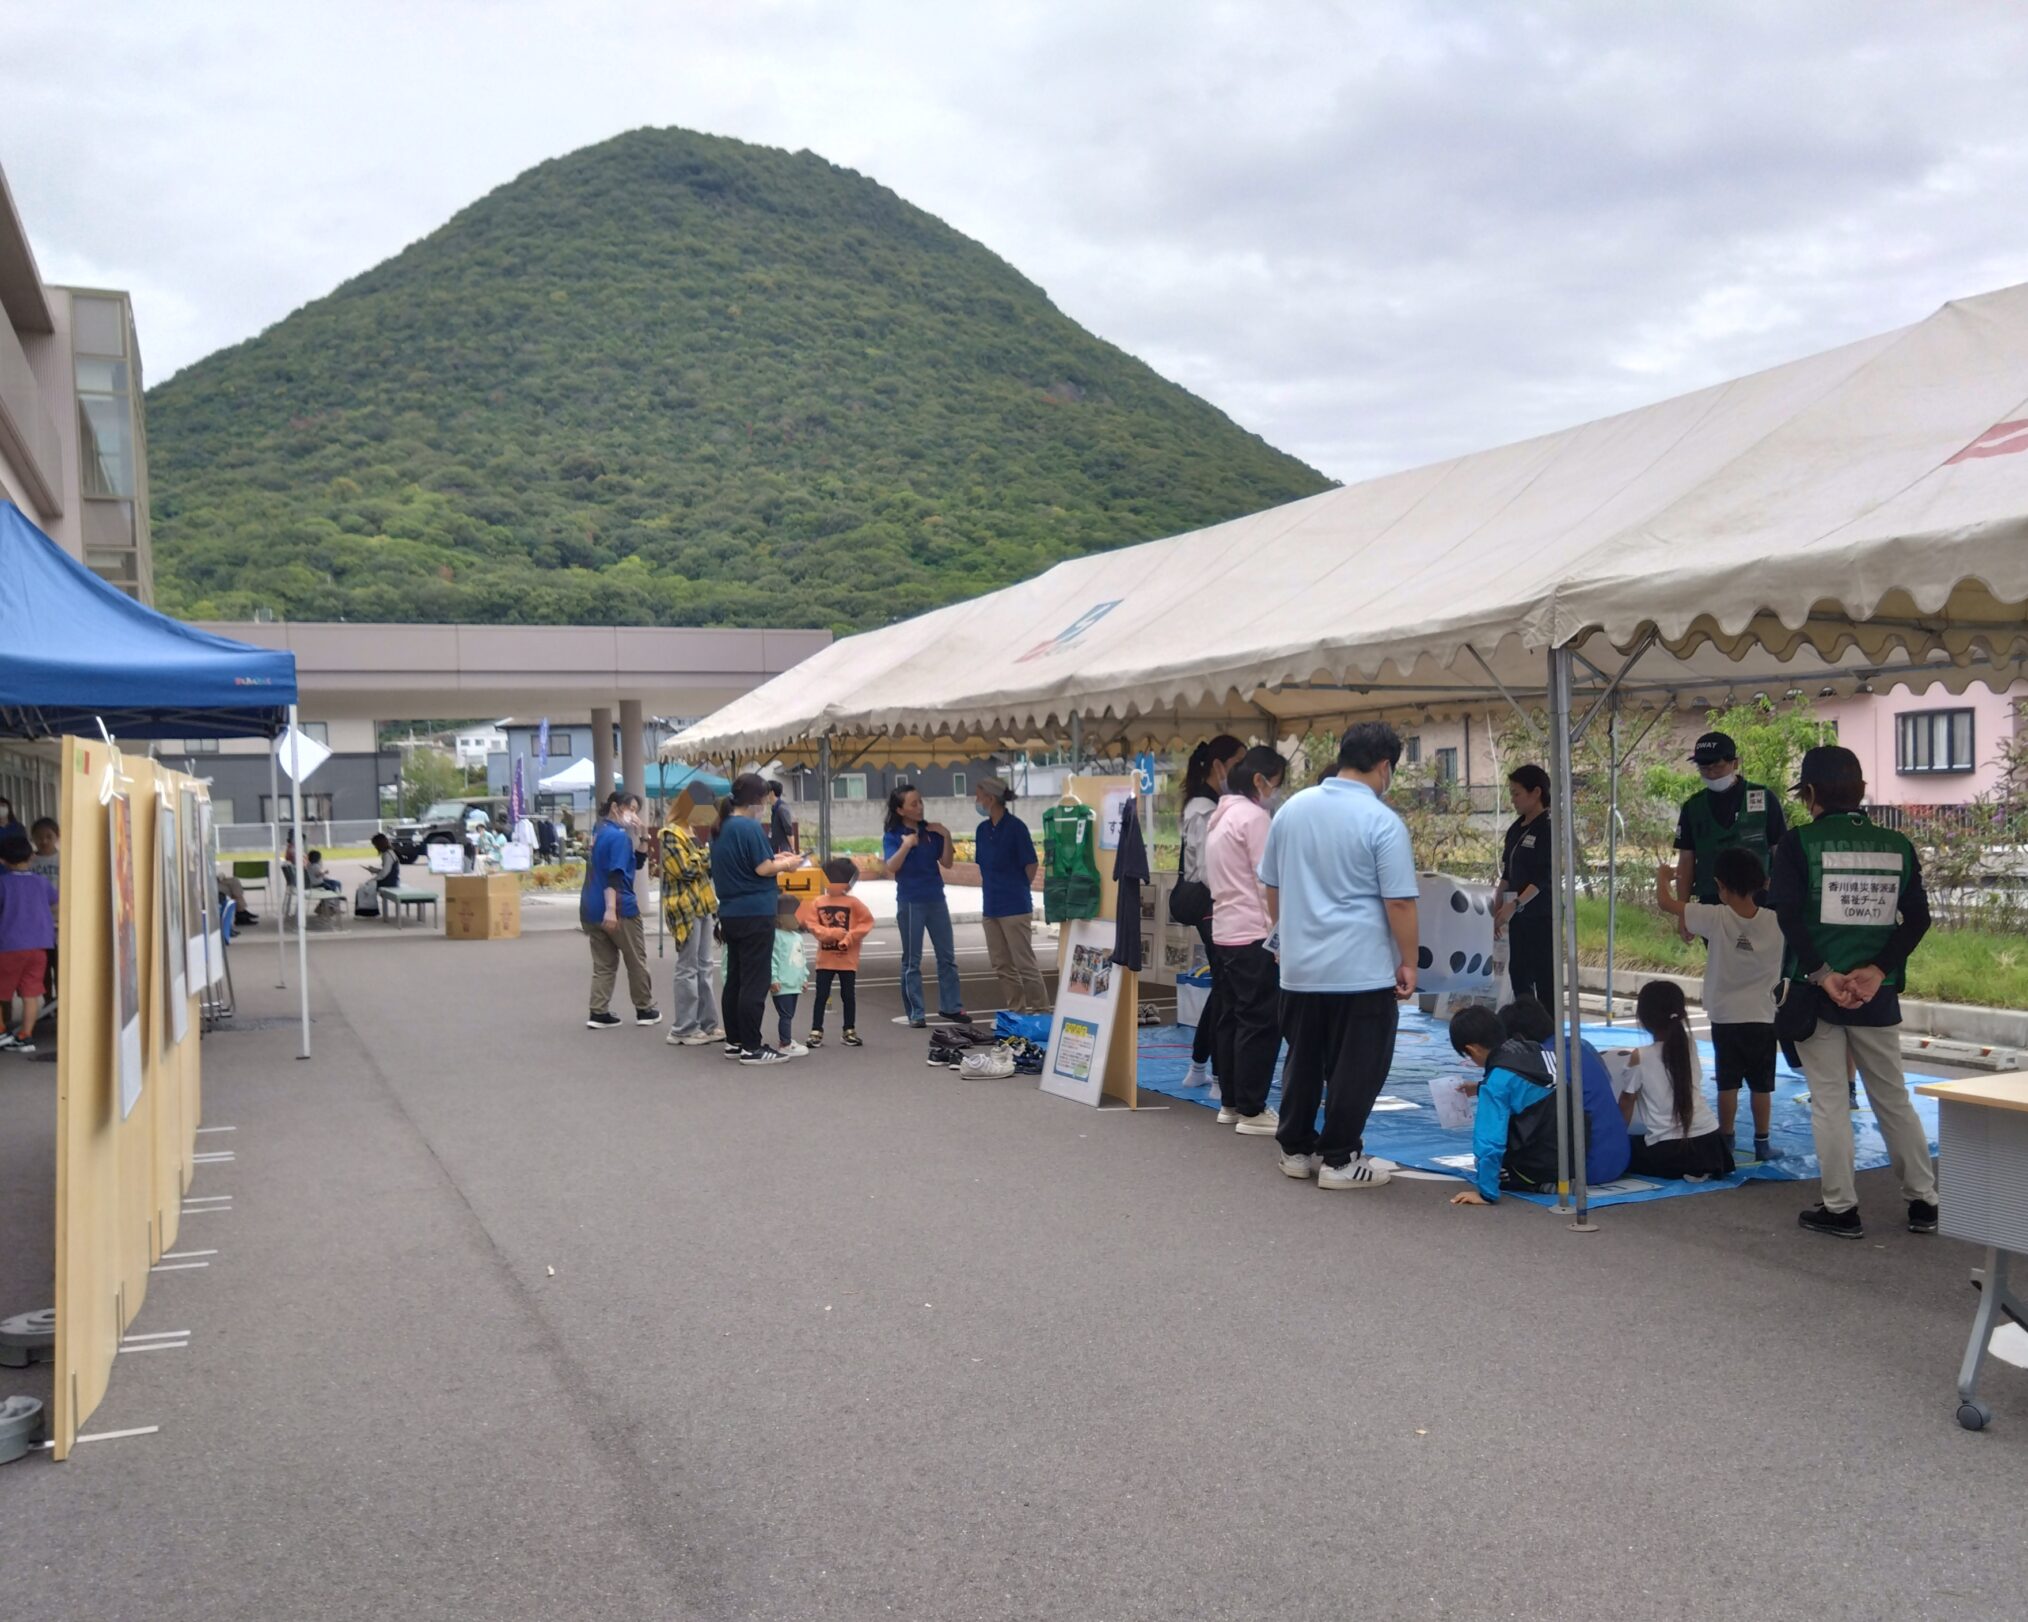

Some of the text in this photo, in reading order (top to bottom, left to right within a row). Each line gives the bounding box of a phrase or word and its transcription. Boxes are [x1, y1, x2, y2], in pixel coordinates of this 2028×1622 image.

[1828, 881, 1896, 893] 香川県災害派遣
[1840, 894, 1886, 905] 福祉チーム
[1844, 907, 1881, 918] (DWAT)
